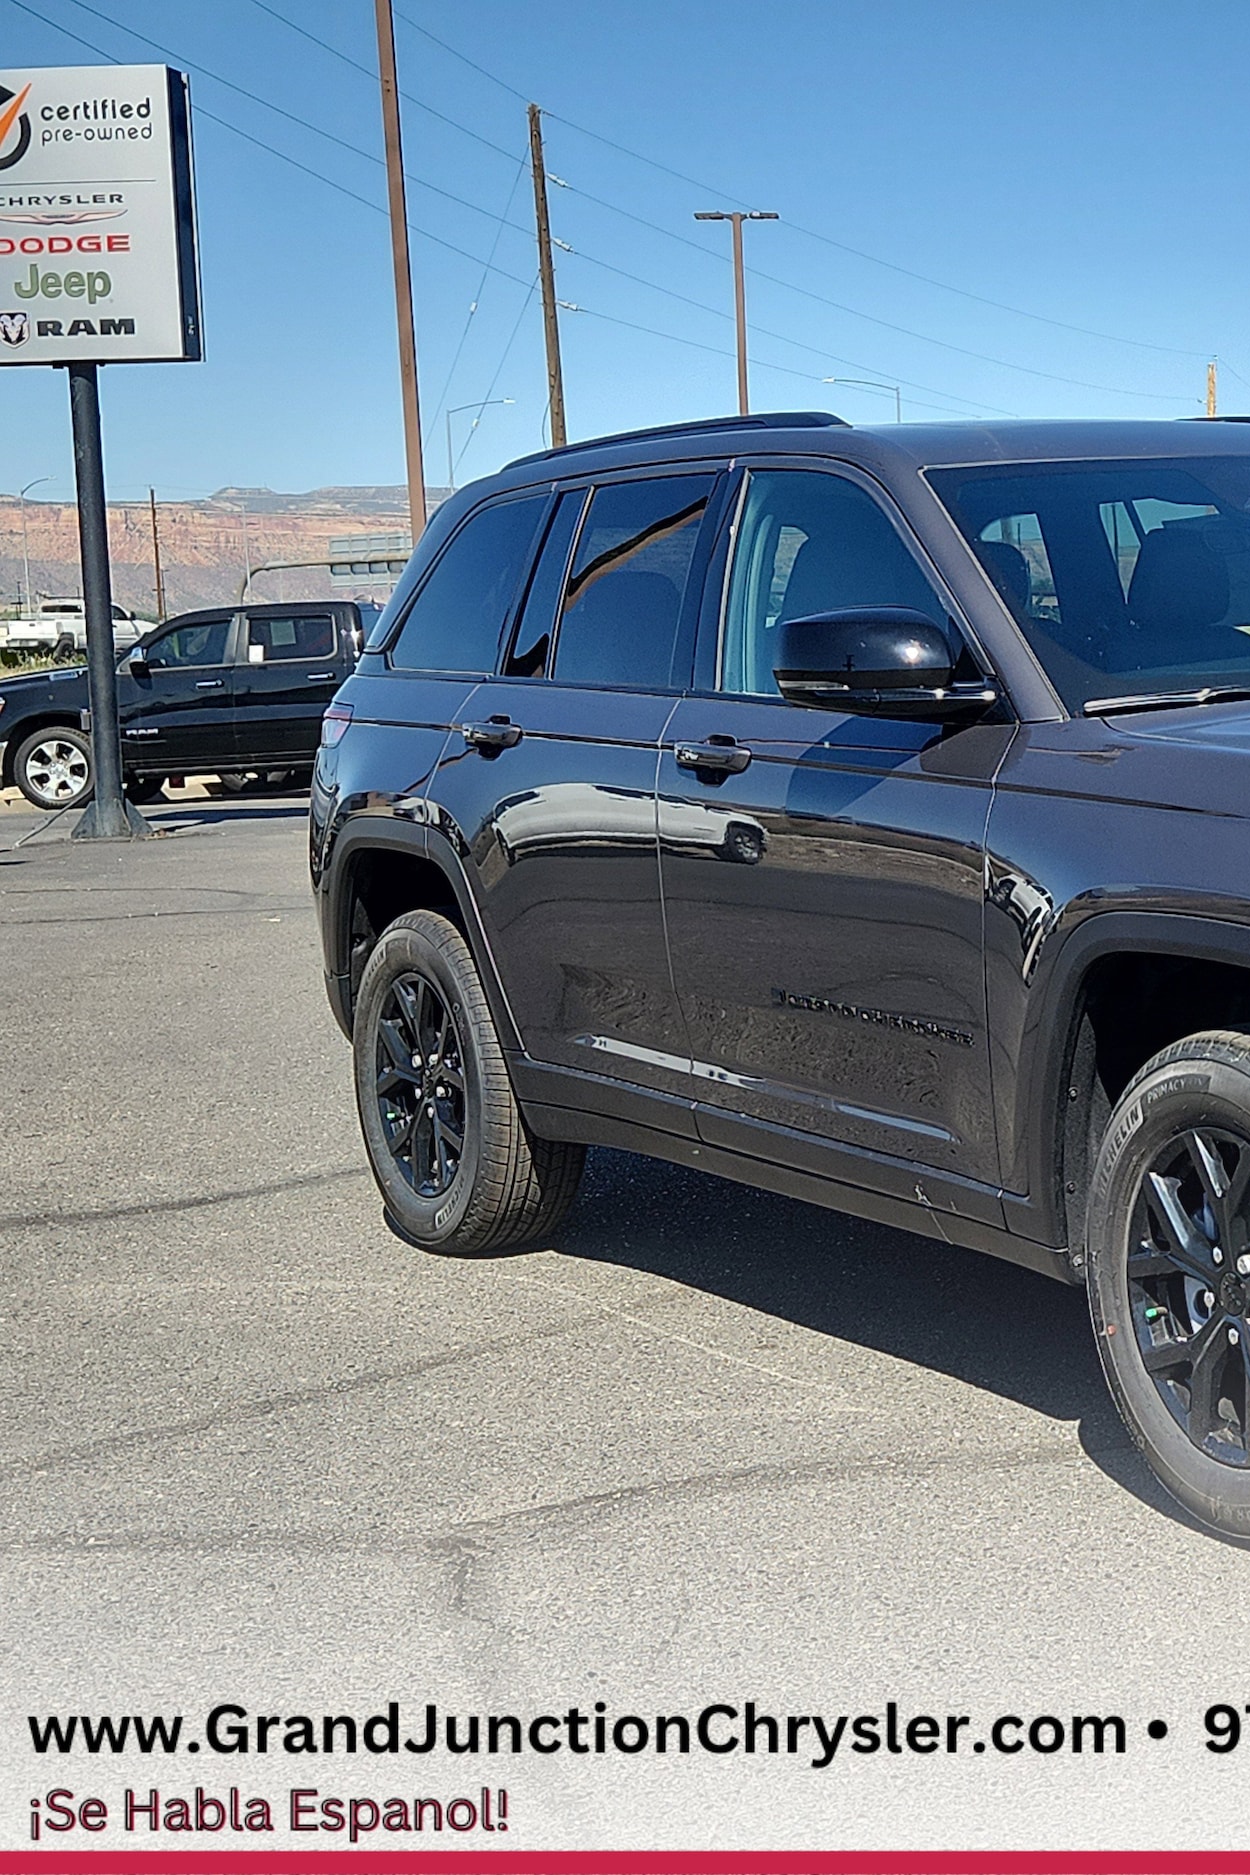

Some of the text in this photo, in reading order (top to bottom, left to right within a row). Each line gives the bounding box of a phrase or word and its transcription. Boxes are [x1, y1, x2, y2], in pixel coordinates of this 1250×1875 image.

[41, 97, 151, 121] certified
[42, 122, 152, 146] pre-owned
[14, 264, 111, 304] Jeep
[37, 318, 135, 337] RAM
[1147, 1079, 1185, 1104] PRIMACY
